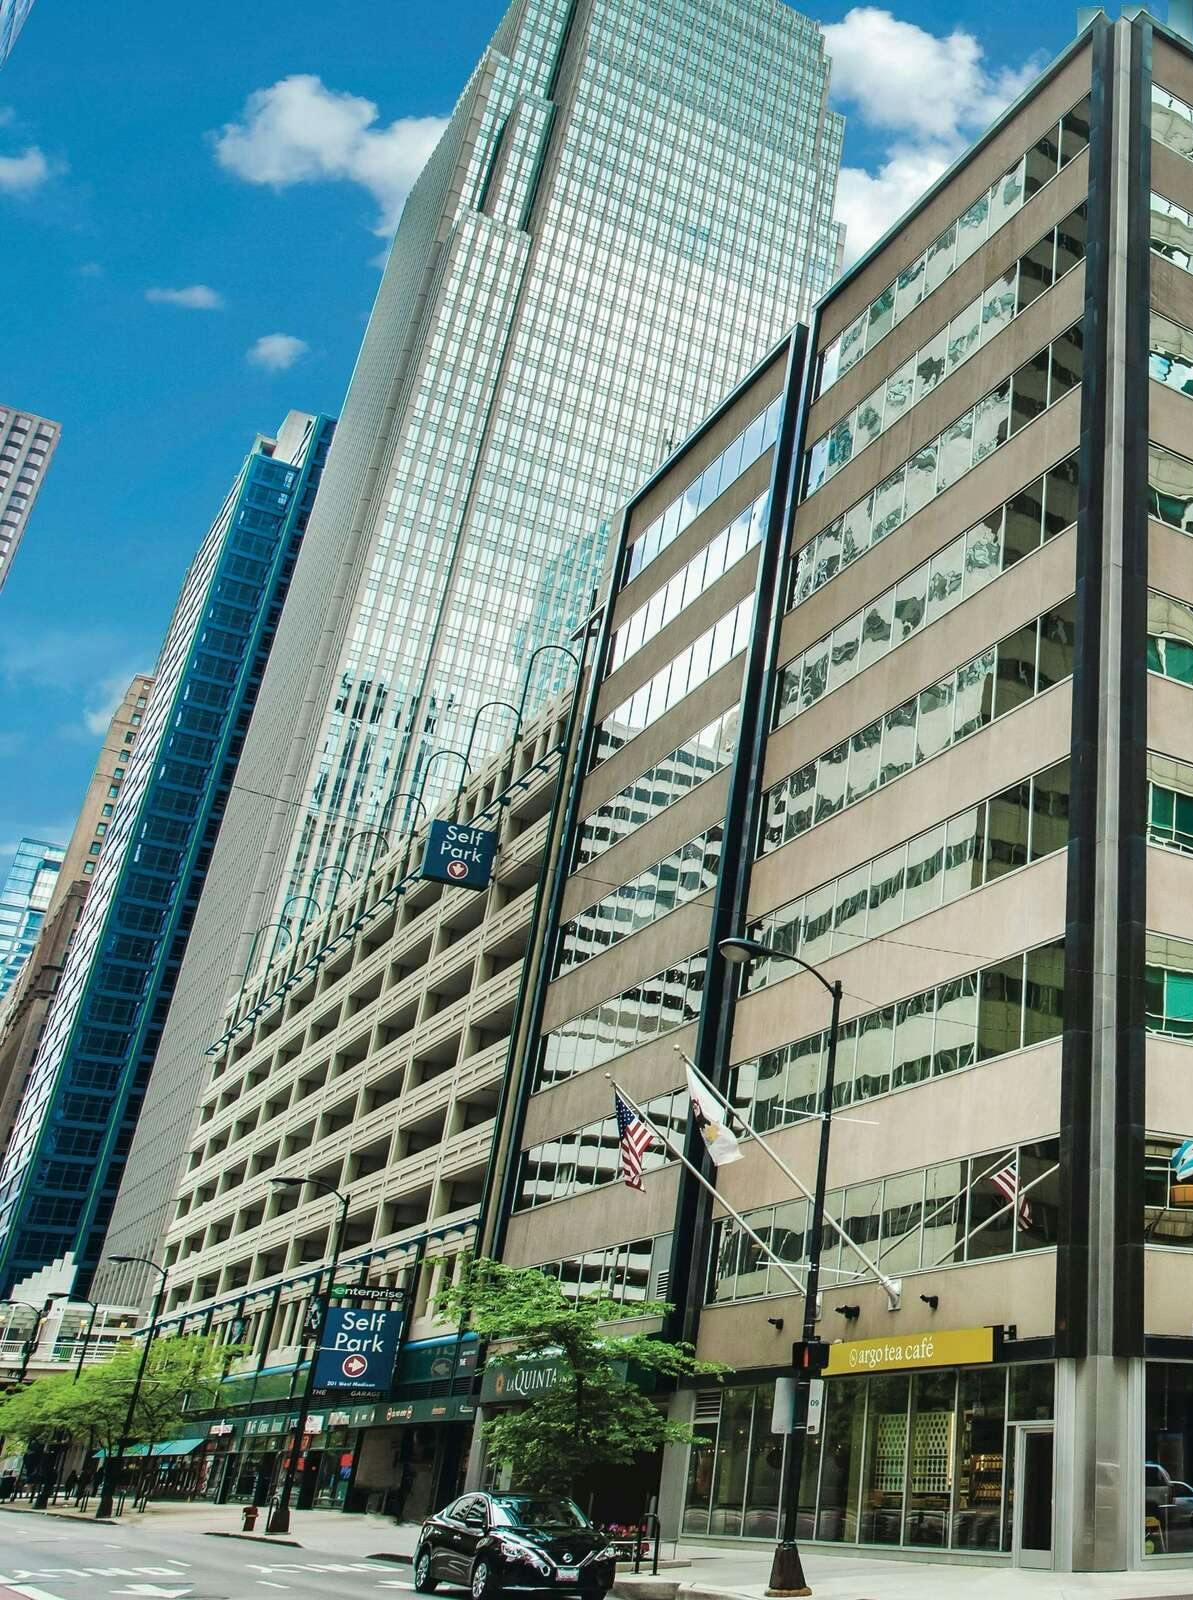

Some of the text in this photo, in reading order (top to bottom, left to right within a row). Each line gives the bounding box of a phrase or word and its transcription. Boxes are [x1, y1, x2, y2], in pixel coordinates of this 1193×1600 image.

[446, 825, 484, 846] Self
[440, 841, 483, 863] Park
[331, 1286, 404, 1299] enterprise
[342, 1311, 386, 1331] Self
[335, 1332, 384, 1353] Park
[858, 1336, 934, 1368] argo tea café
[506, 1380, 515, 1392] LA
[514, 1367, 557, 1396] QUINTA
